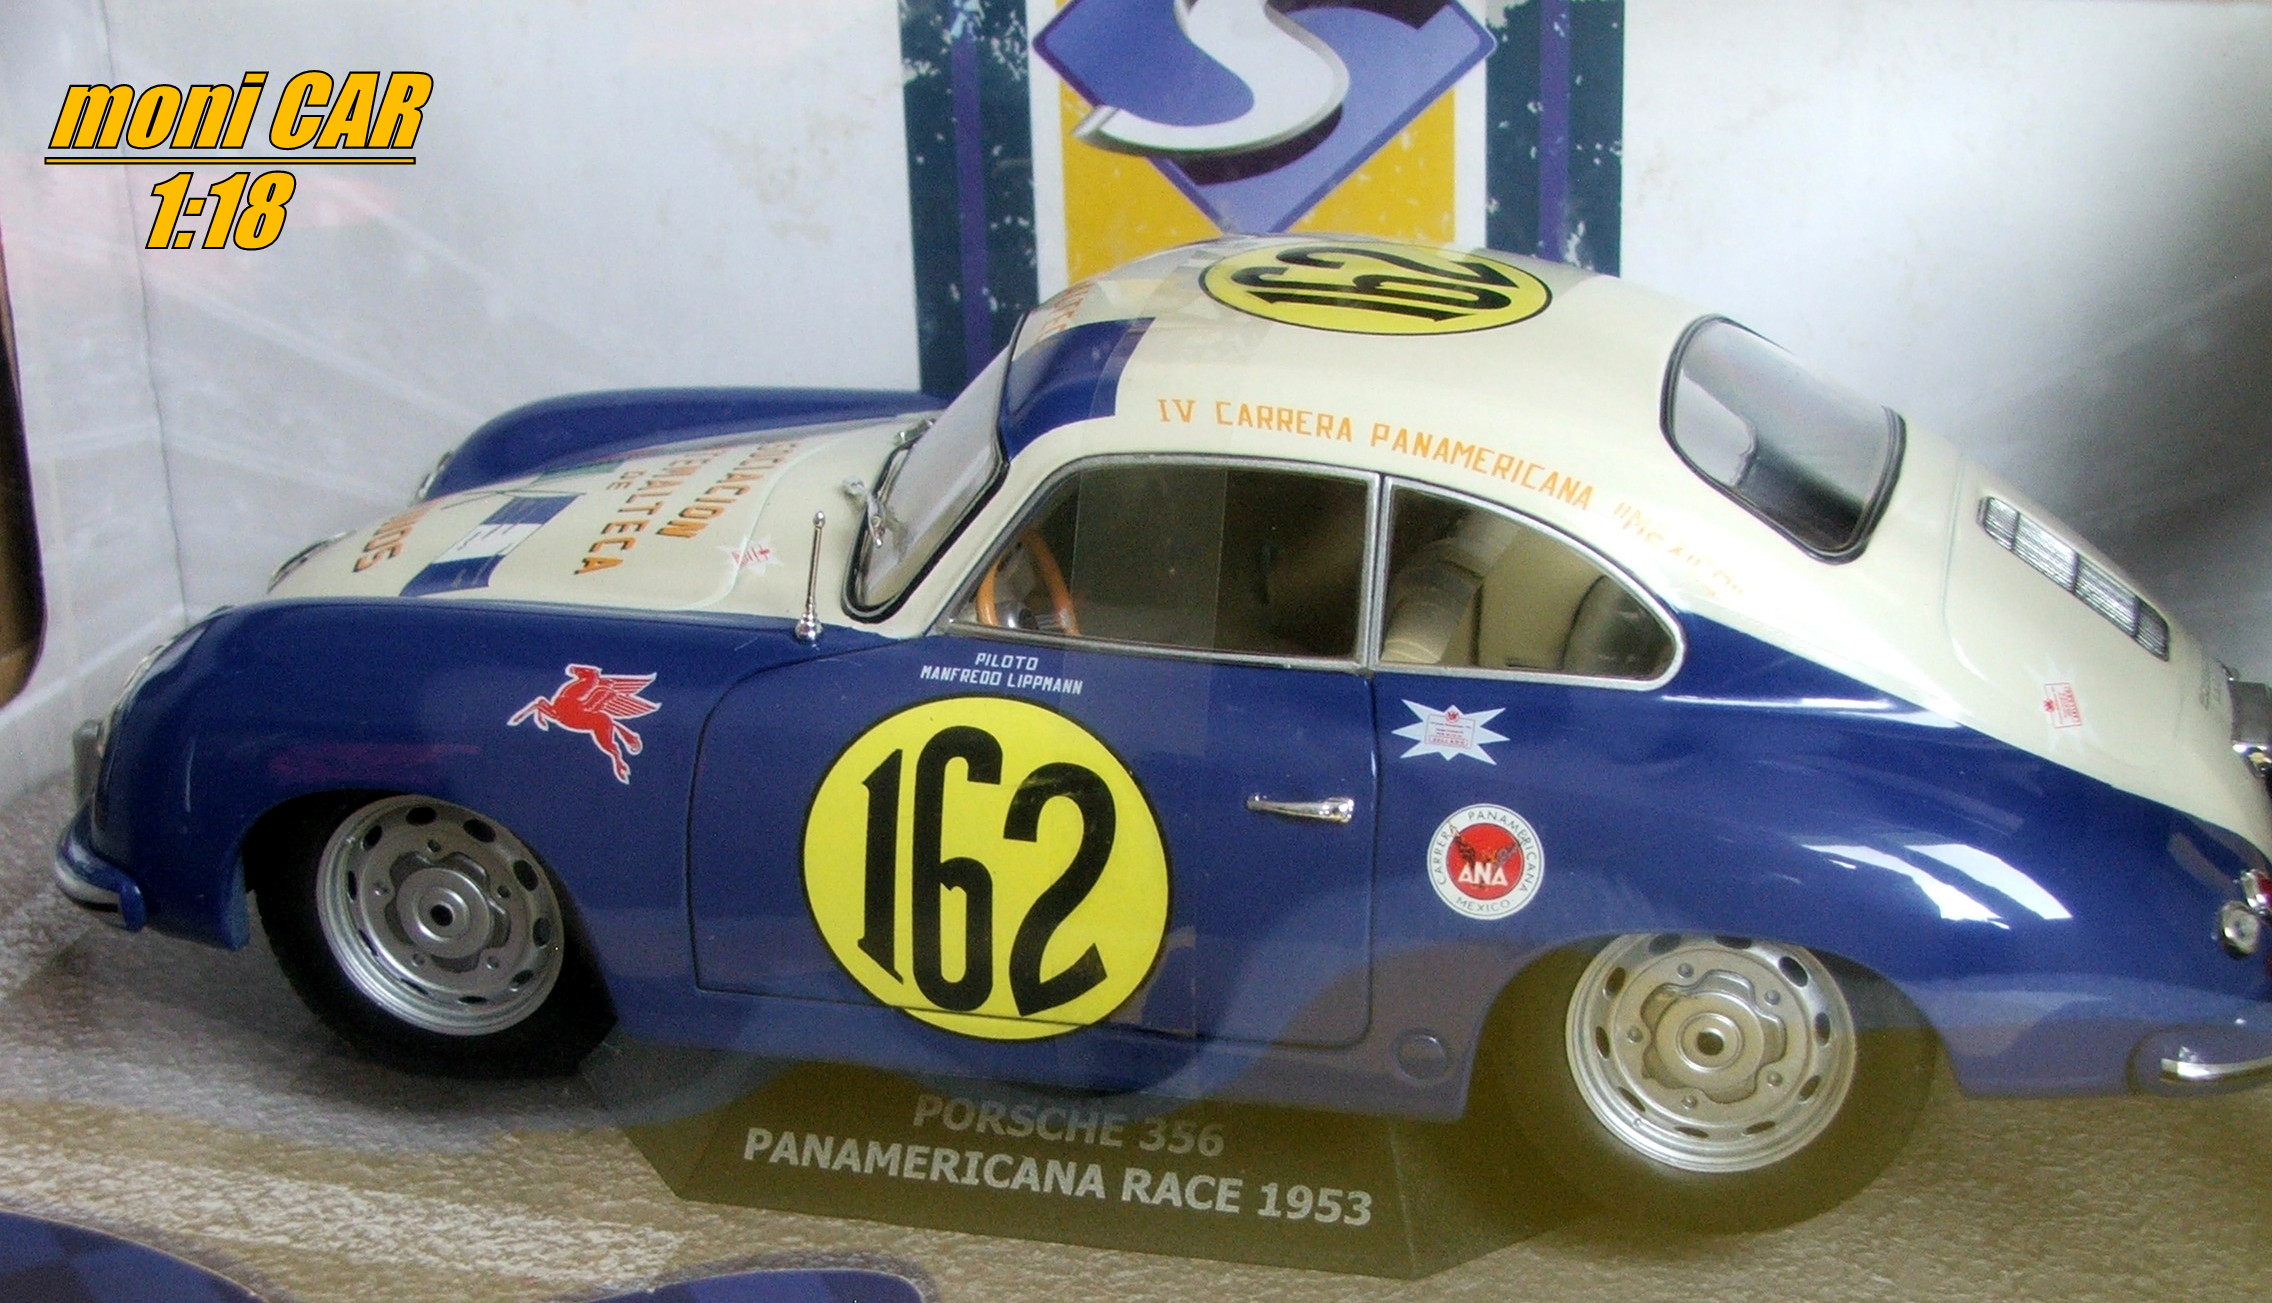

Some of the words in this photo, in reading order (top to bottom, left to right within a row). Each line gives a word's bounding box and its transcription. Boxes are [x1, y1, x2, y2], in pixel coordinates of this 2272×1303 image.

[1230, 245, 1518, 322] 162
[1157, 398, 1195, 423] IV
[1215, 400, 1352, 442] CARRERA
[1370, 422, 1595, 511] PANAMERICANA
[920, 665, 1003, 686] MANFREDO
[1006, 673, 1084, 695] LIPPMANN
[974, 652, 1039, 671] PILOTO
[857, 725, 1116, 1018] 162
[1434, 822, 1459, 886] CARRERA
[1467, 810, 1538, 893] PANAMERICANA
[1458, 861, 1508, 886] ANA
[1455, 896, 1512, 912] MEXICO
[912, 1093, 1128, 1149] PORSCHE
[1138, 1119, 1225, 1157] 356
[743, 1126, 1108, 1201] PANAMERICANA
[1120, 1166, 1243, 1215] RACE
[1255, 1182, 1373, 1227] 1953
